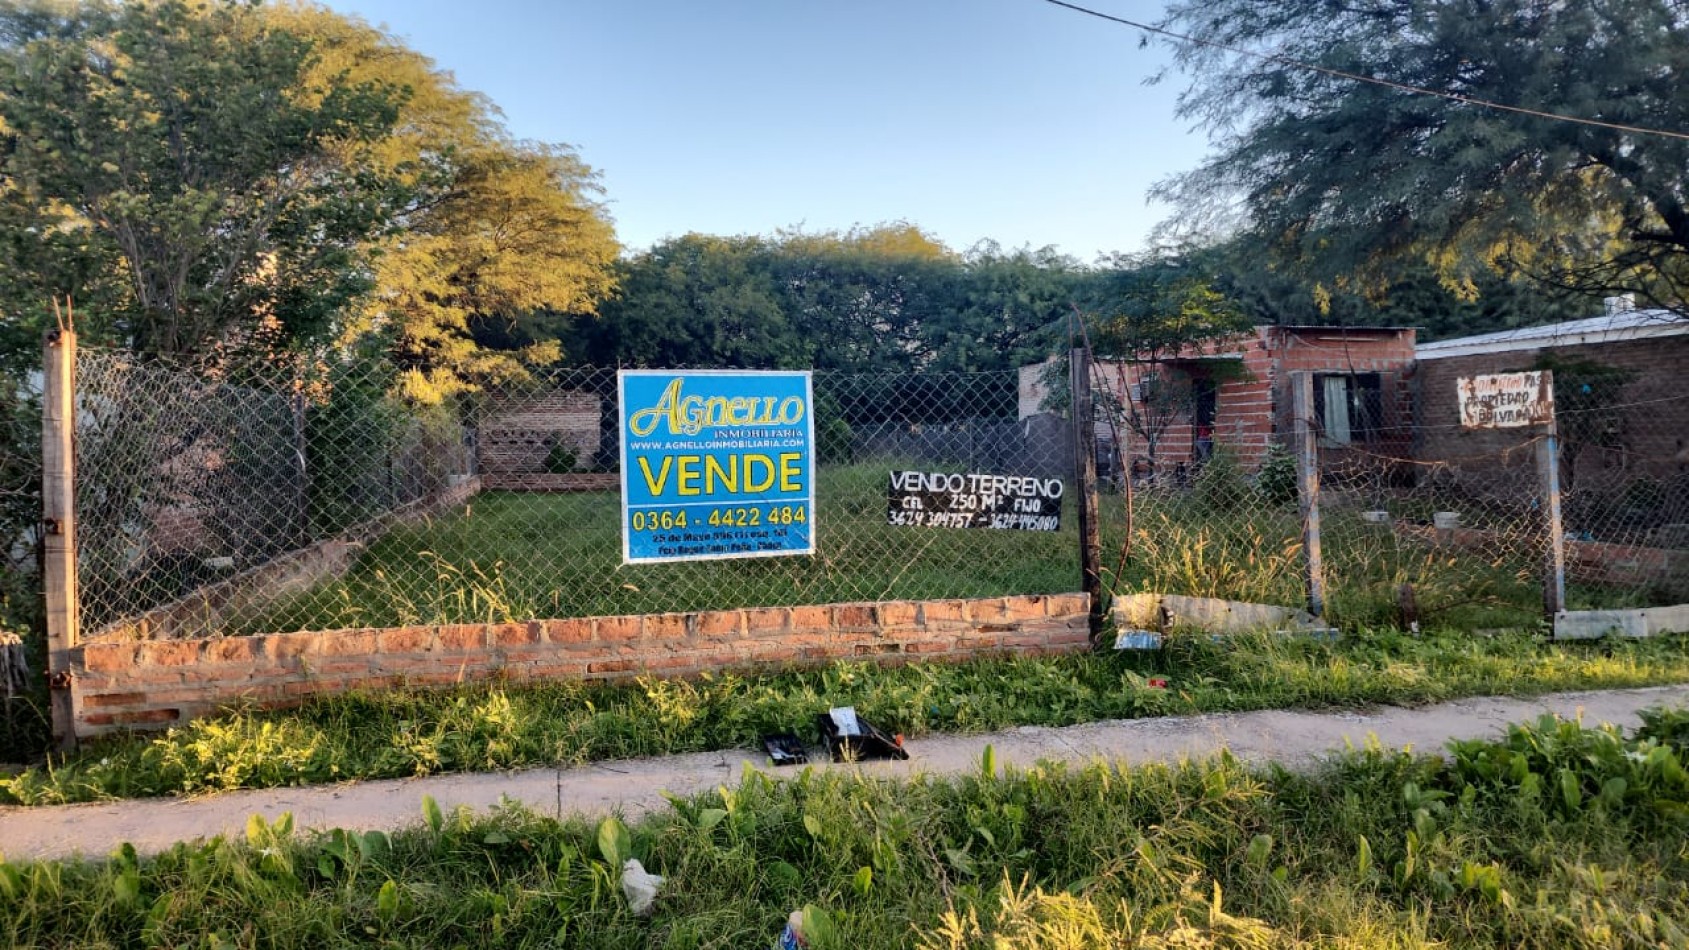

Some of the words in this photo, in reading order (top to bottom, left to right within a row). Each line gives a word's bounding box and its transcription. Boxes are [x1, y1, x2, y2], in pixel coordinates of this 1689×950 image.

[714, 428, 803, 439] INMOBILIARIA
[630, 439, 804, 450] WWW.AGNELLOINMOBILIARIA.COM
[638, 452, 803, 497] VENDE
[890, 471, 964, 493] VENDO
[967, 474, 1063, 499] TERRENO
[949, 494, 978, 510] 250
[1014, 498, 1042, 512] FIJO
[632, 510, 687, 531] 0364
[708, 507, 760, 527] 4422
[767, 506, 806, 525] 484
[888, 511, 924, 526] 3624
